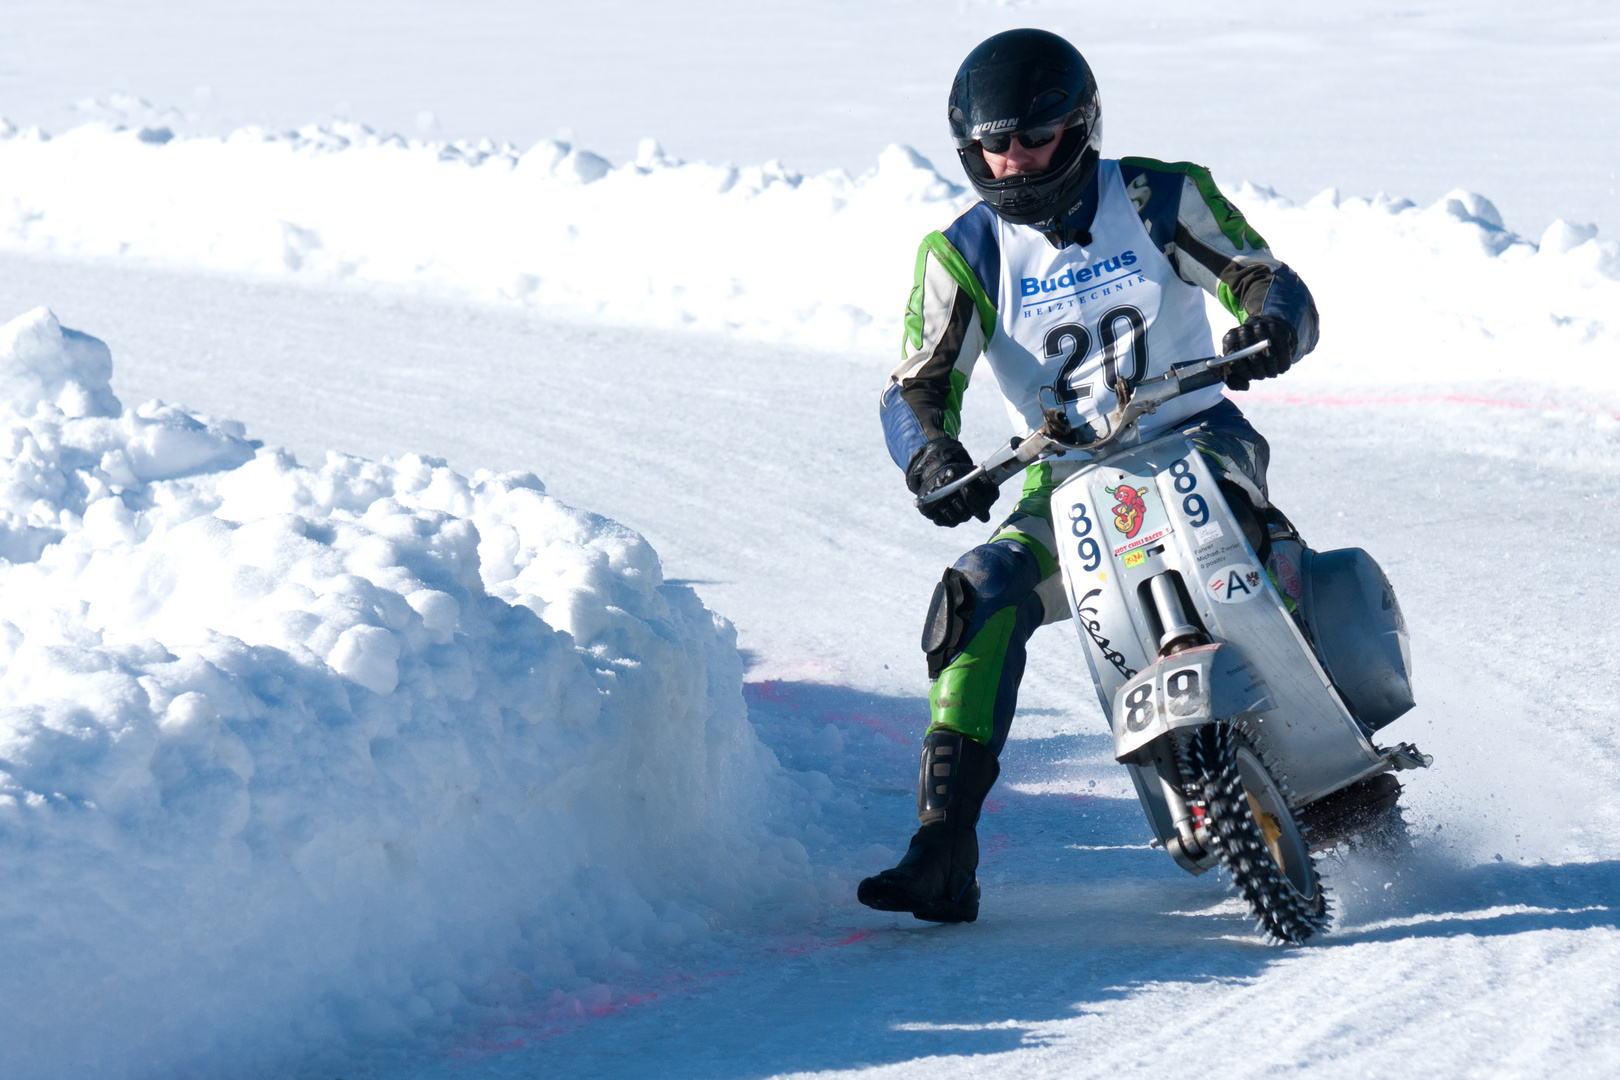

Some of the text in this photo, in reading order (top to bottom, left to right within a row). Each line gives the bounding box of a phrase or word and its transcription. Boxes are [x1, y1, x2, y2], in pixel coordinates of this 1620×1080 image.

[971, 118, 1019, 134] NOLAN
[1021, 250, 1137, 297] Buderus
[1024, 275, 1146, 318] HEIZTECHNIK
[1043, 304, 1149, 405] 20
[1114, 545, 1128, 555] HOT
[1127, 538, 1145, 549] CHILI
[1226, 570, 1251, 599] A
